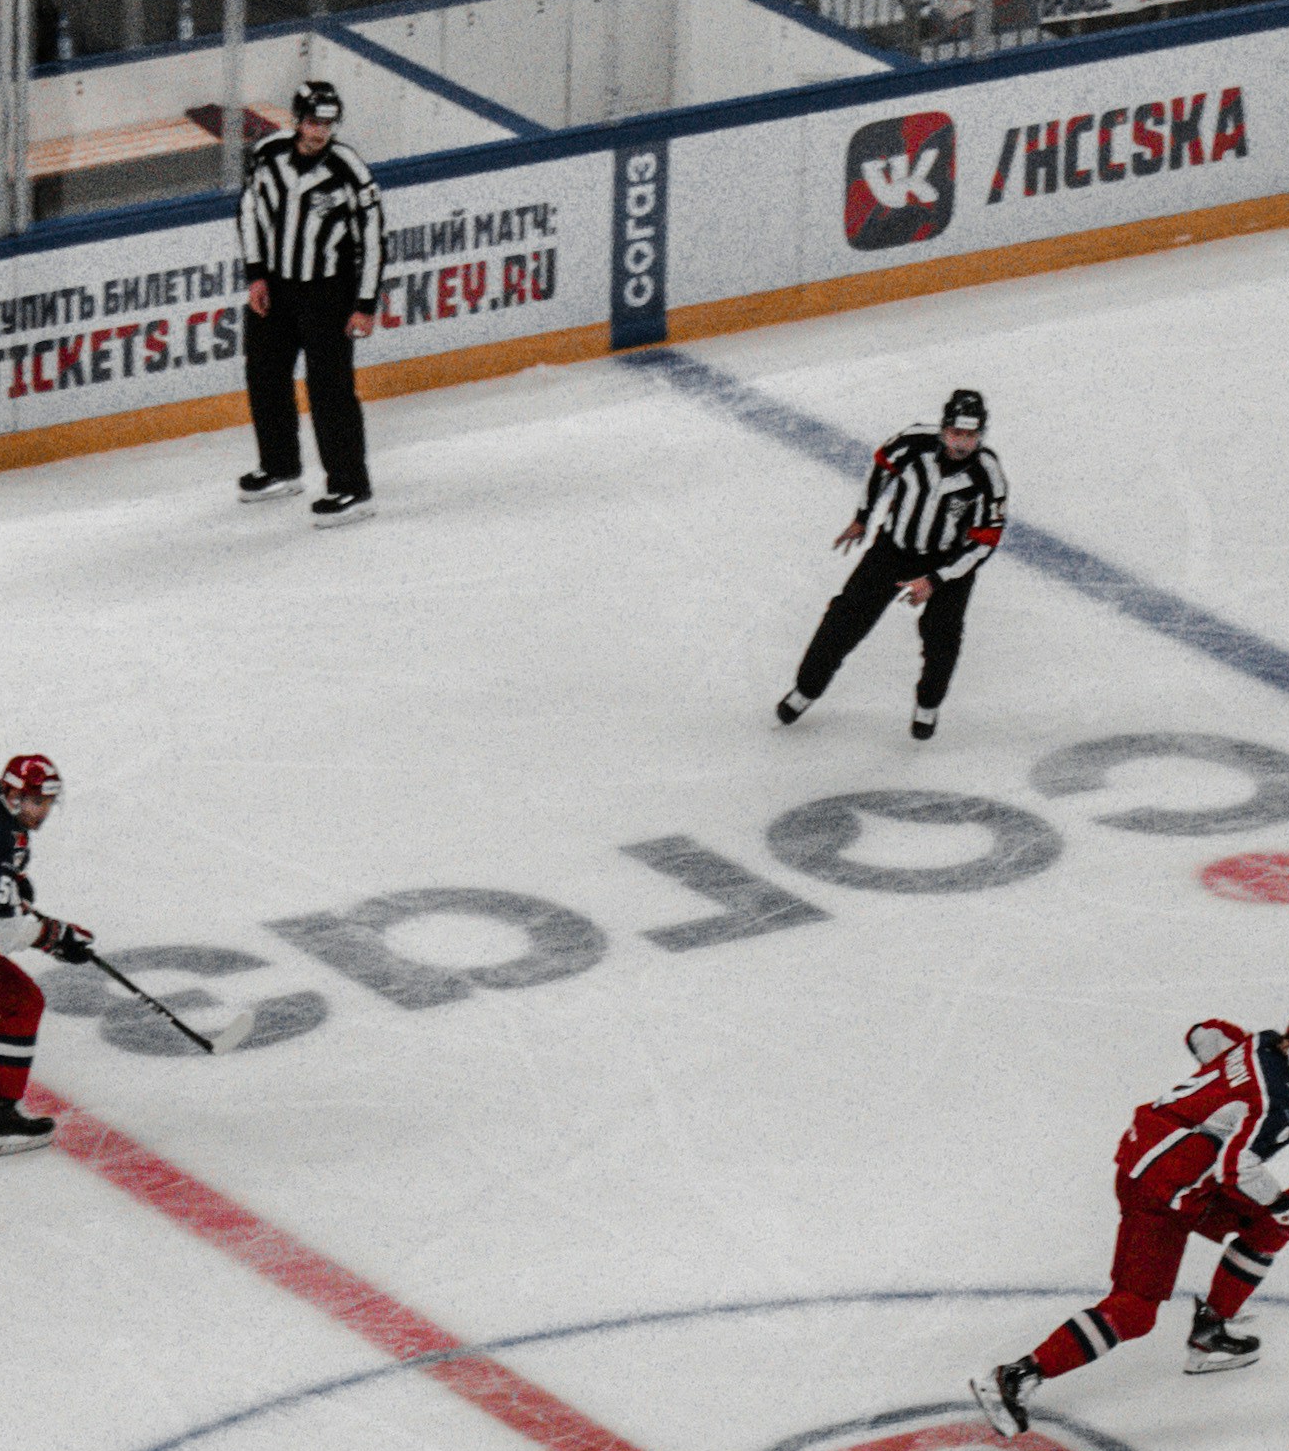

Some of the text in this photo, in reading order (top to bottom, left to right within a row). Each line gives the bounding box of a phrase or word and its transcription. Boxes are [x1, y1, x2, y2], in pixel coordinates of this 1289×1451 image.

[986, 86, 1251, 205] /HCCSKA
[103, 263, 225, 317] БИЛЕТЫ
[472, 201, 560, 253] МАТЧ:
